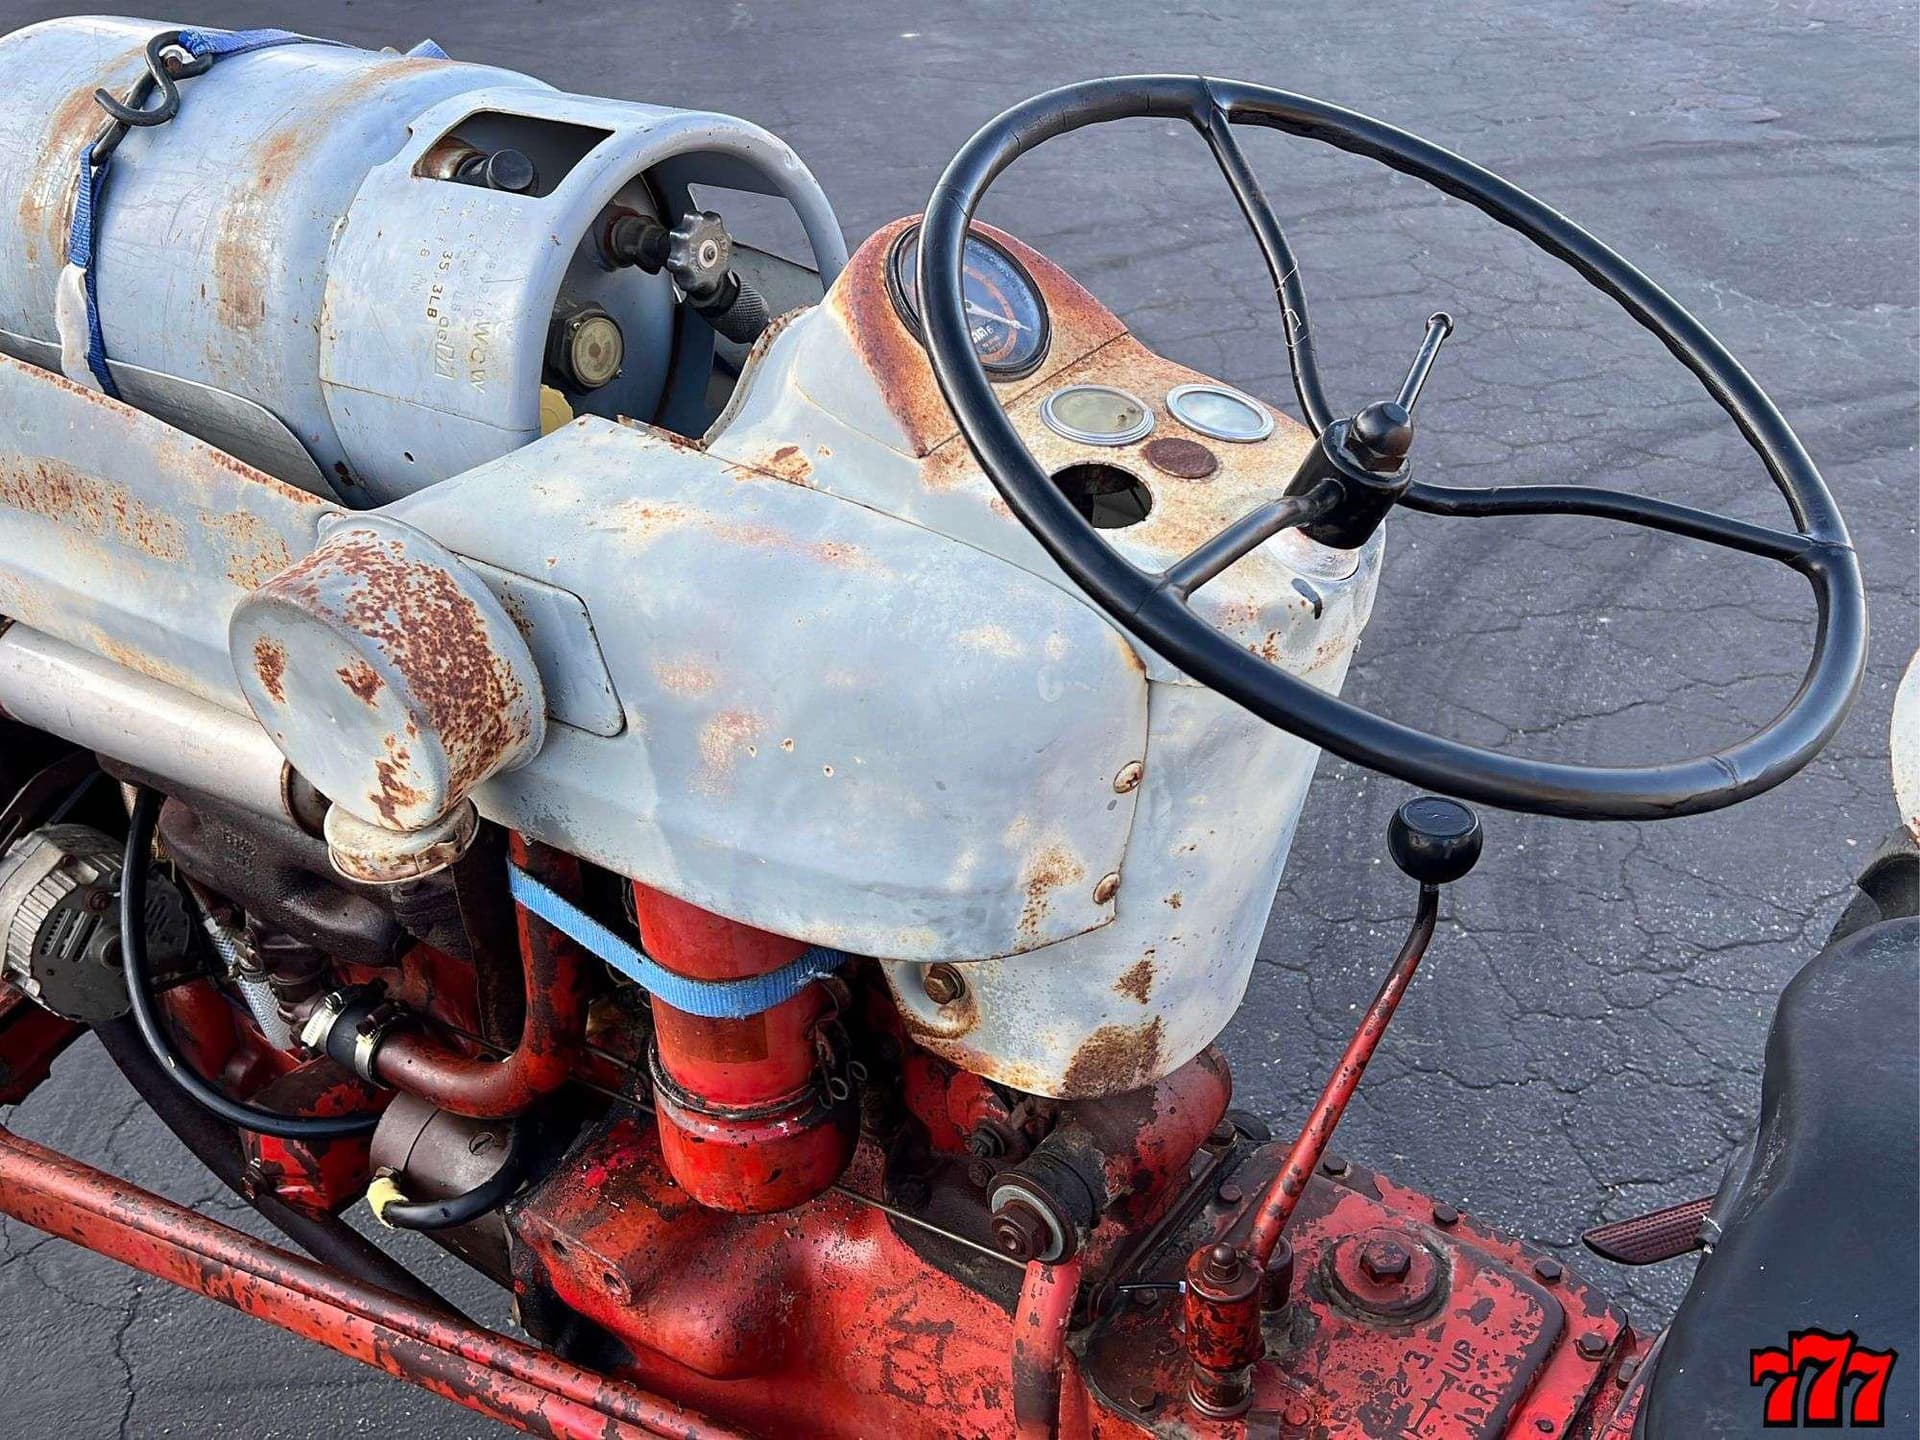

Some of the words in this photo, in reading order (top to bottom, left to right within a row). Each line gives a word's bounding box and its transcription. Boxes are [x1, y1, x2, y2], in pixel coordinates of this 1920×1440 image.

[1403, 1350, 1434, 1370] 3
[1445, 1339, 1476, 1373] UP
[1468, 1383, 1504, 1405] R
